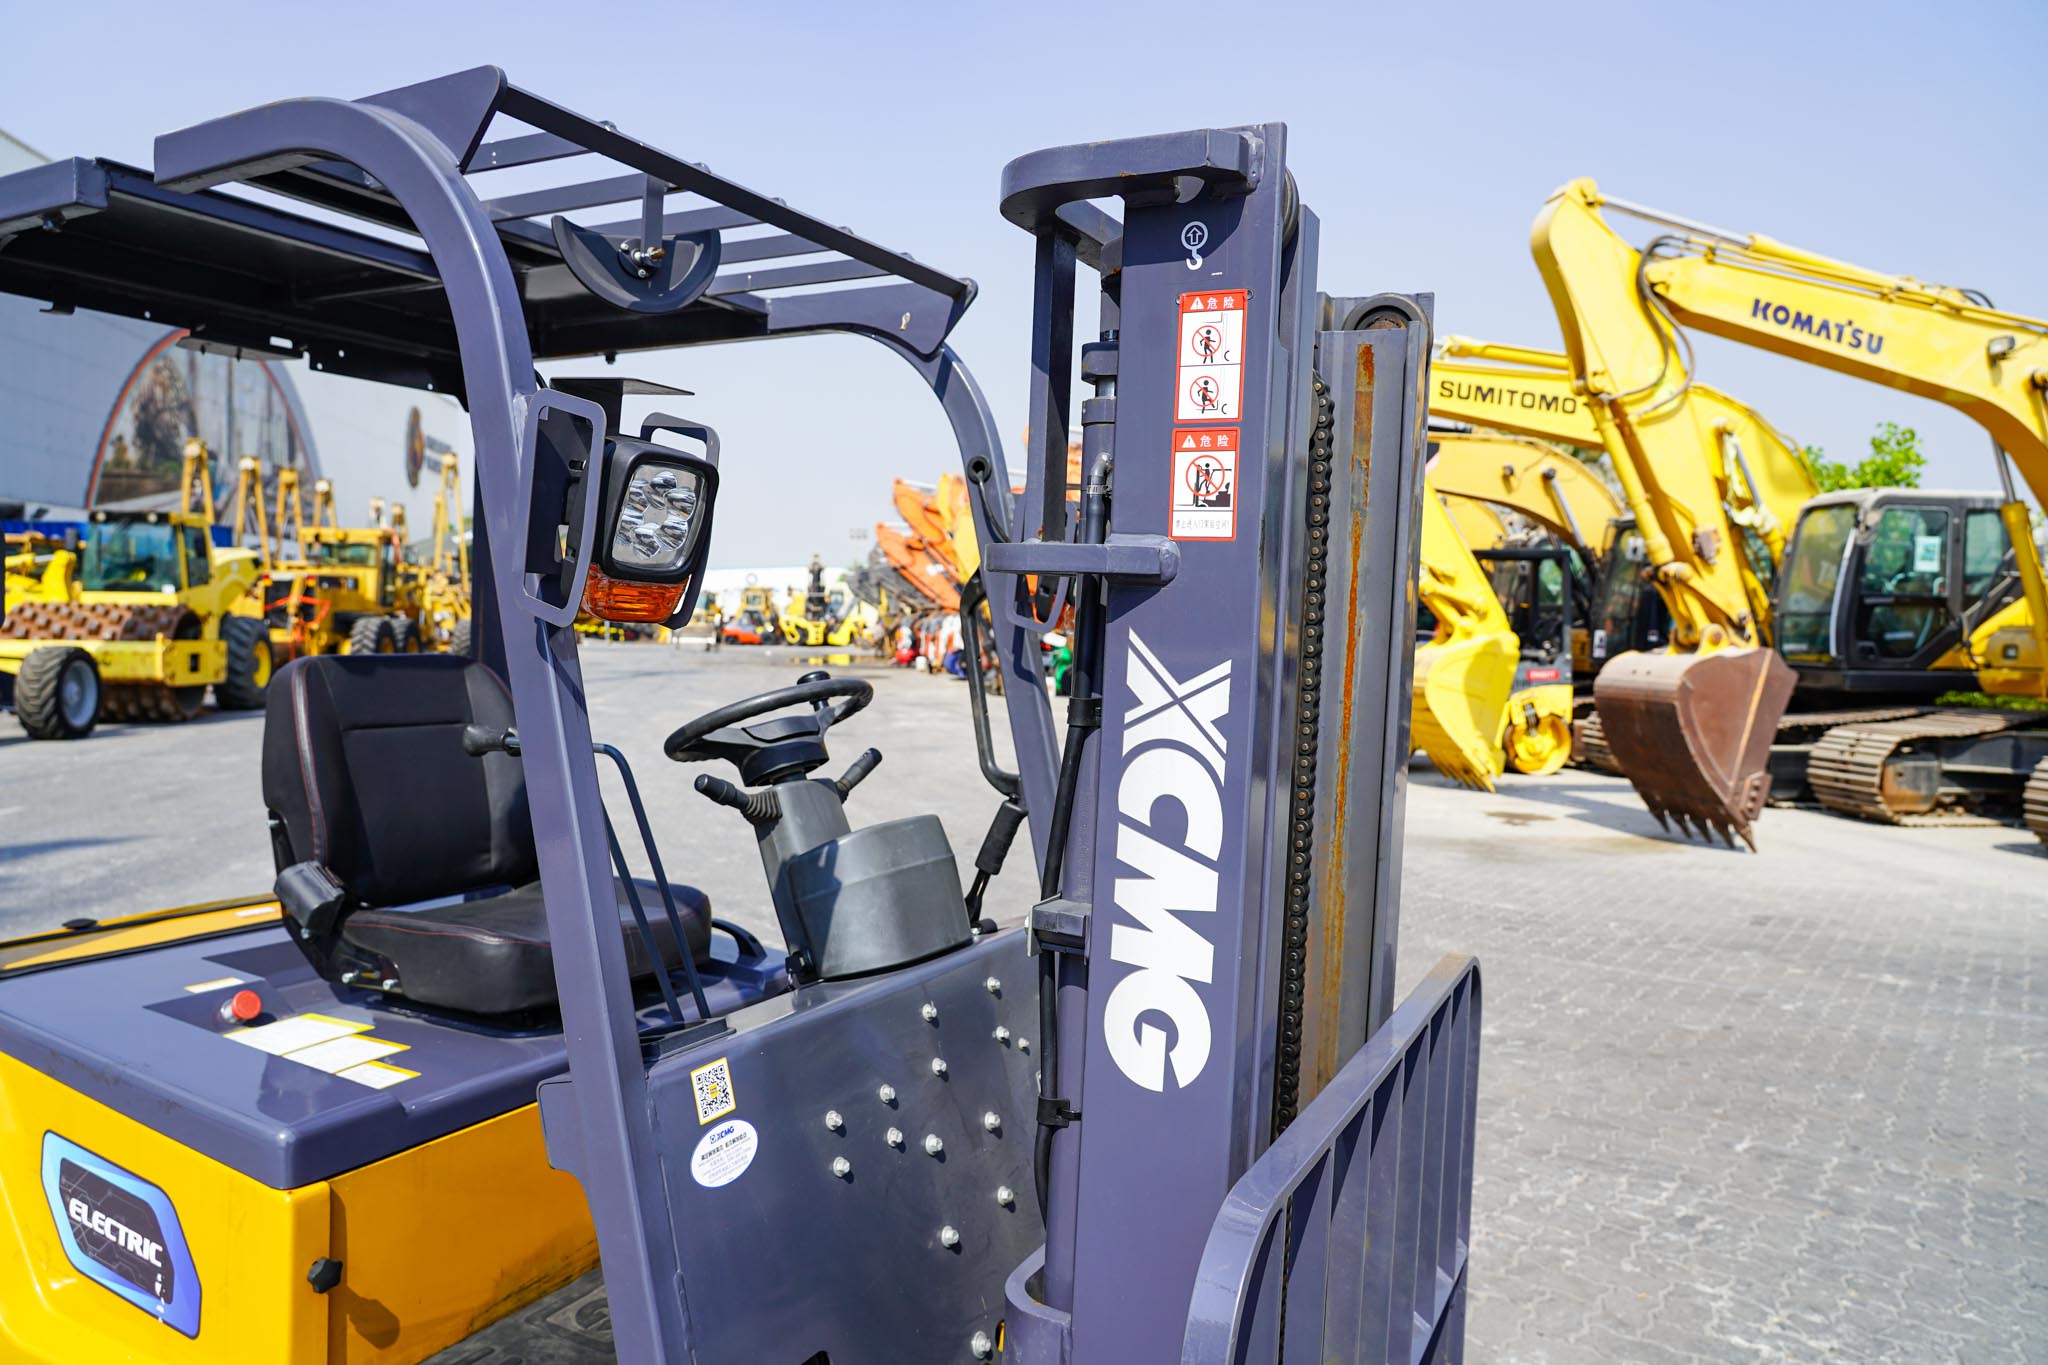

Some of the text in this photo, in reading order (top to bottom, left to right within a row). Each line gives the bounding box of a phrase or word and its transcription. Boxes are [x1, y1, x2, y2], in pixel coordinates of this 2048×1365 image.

[1207, 296, 1235, 310] 危险
[1752, 298, 1884, 355] KOMATSU
[1440, 380, 1577, 414] SUMITOMO
[1200, 434, 1230, 448] 危险
[1104, 626, 1233, 1093] XCMG
[69, 1197, 163, 1268] ELECTRIC
